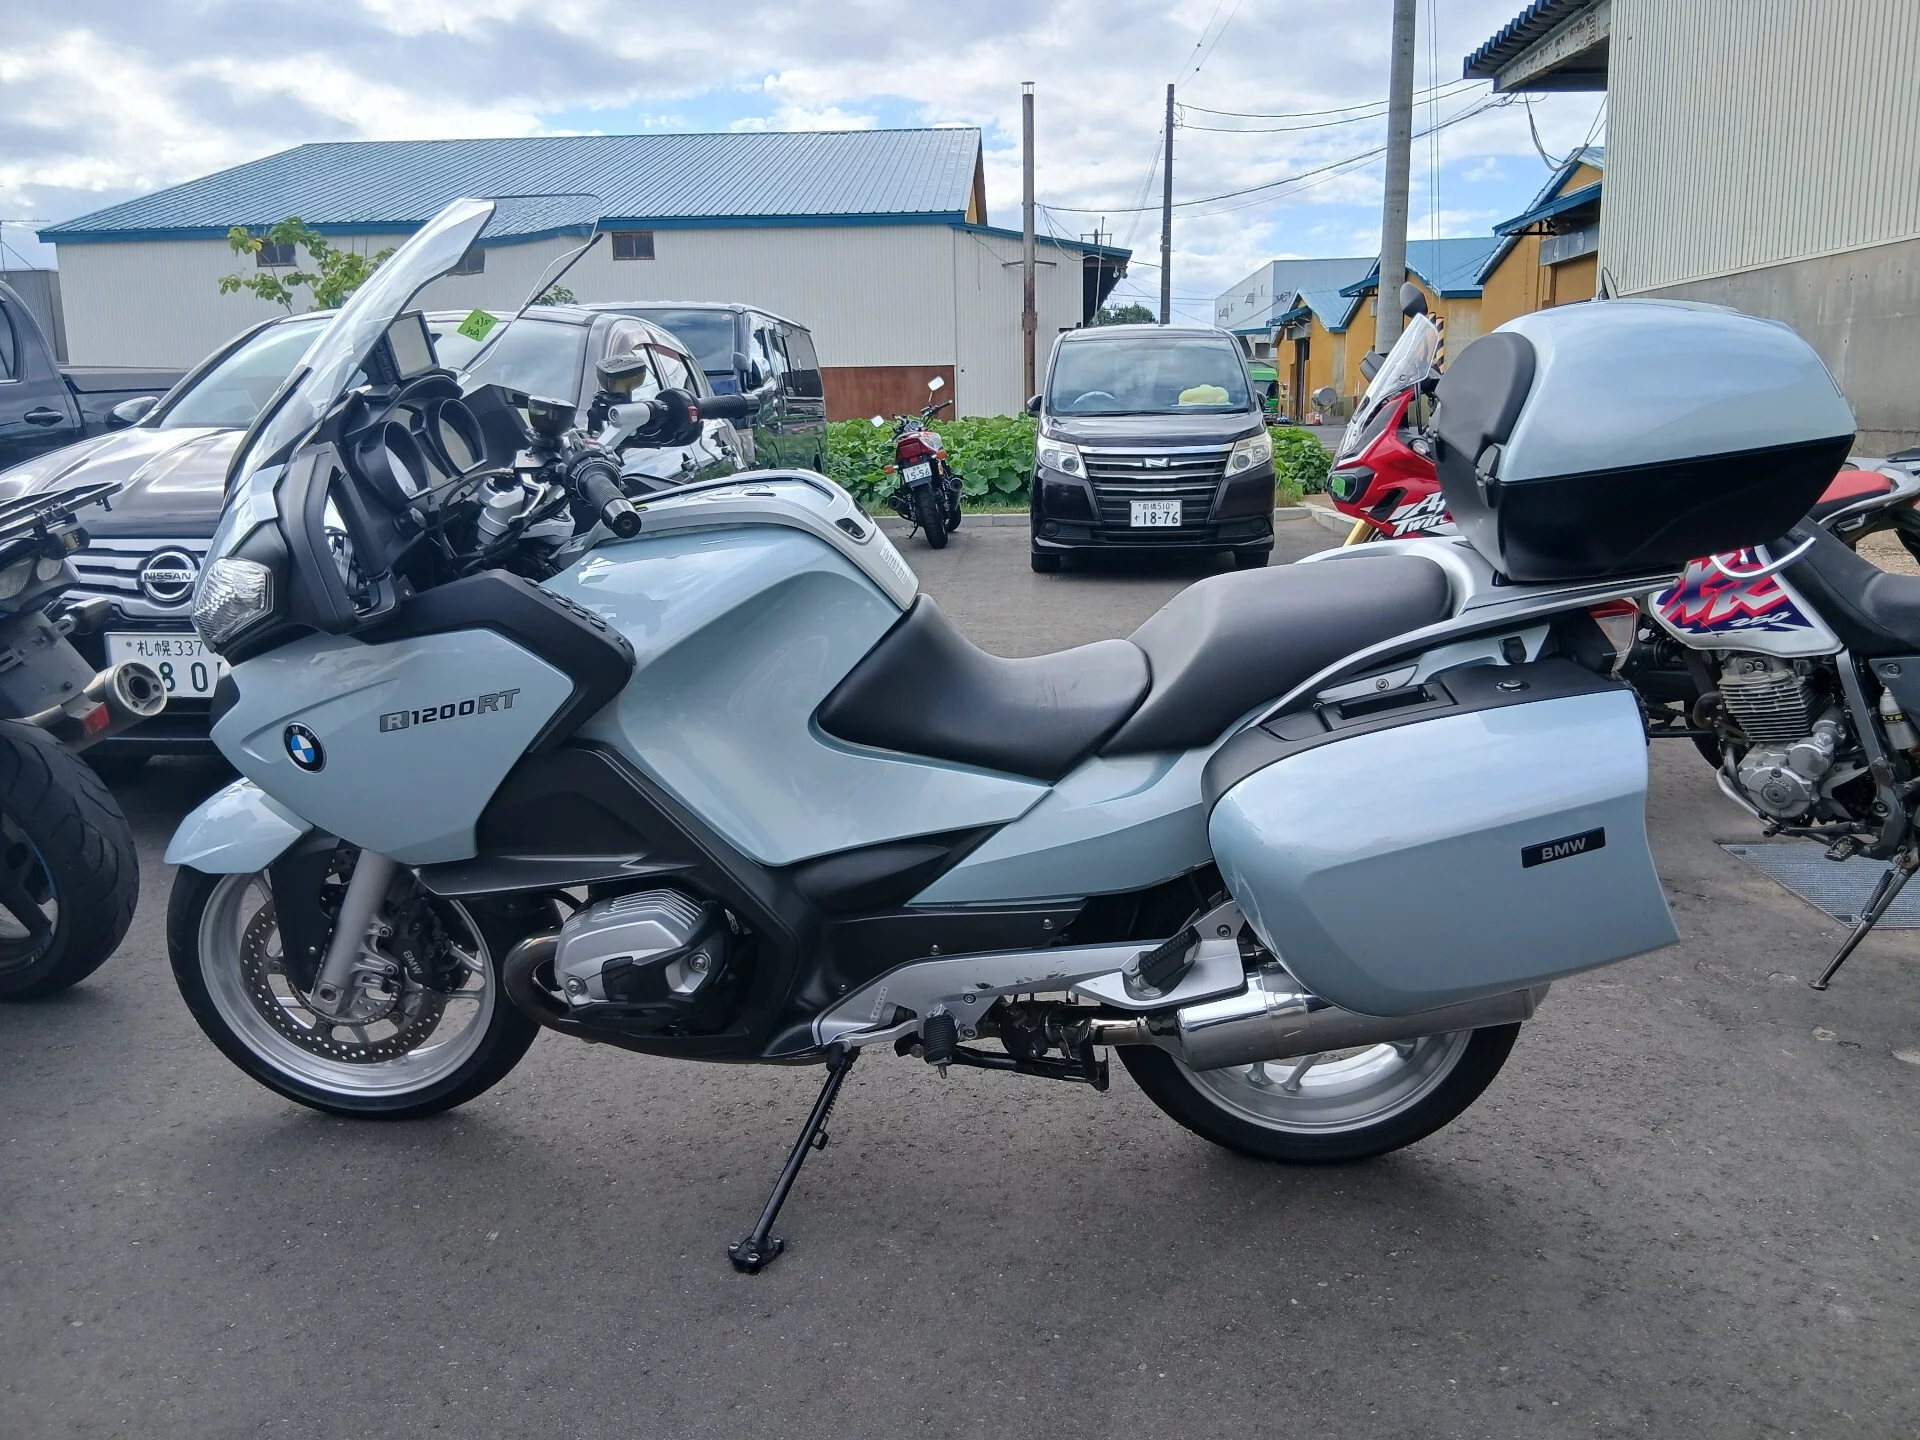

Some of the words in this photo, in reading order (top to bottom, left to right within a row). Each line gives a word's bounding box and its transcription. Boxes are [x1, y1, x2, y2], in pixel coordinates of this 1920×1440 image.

[906, 468, 930, 481] 15-56
[1144, 511, 1178, 525] 18-76
[143, 572, 192, 580] NISSAN
[1729, 611, 1792, 627] 250
[1541, 838, 1586, 860] BMW
[404, 950, 423, 974] BMW
